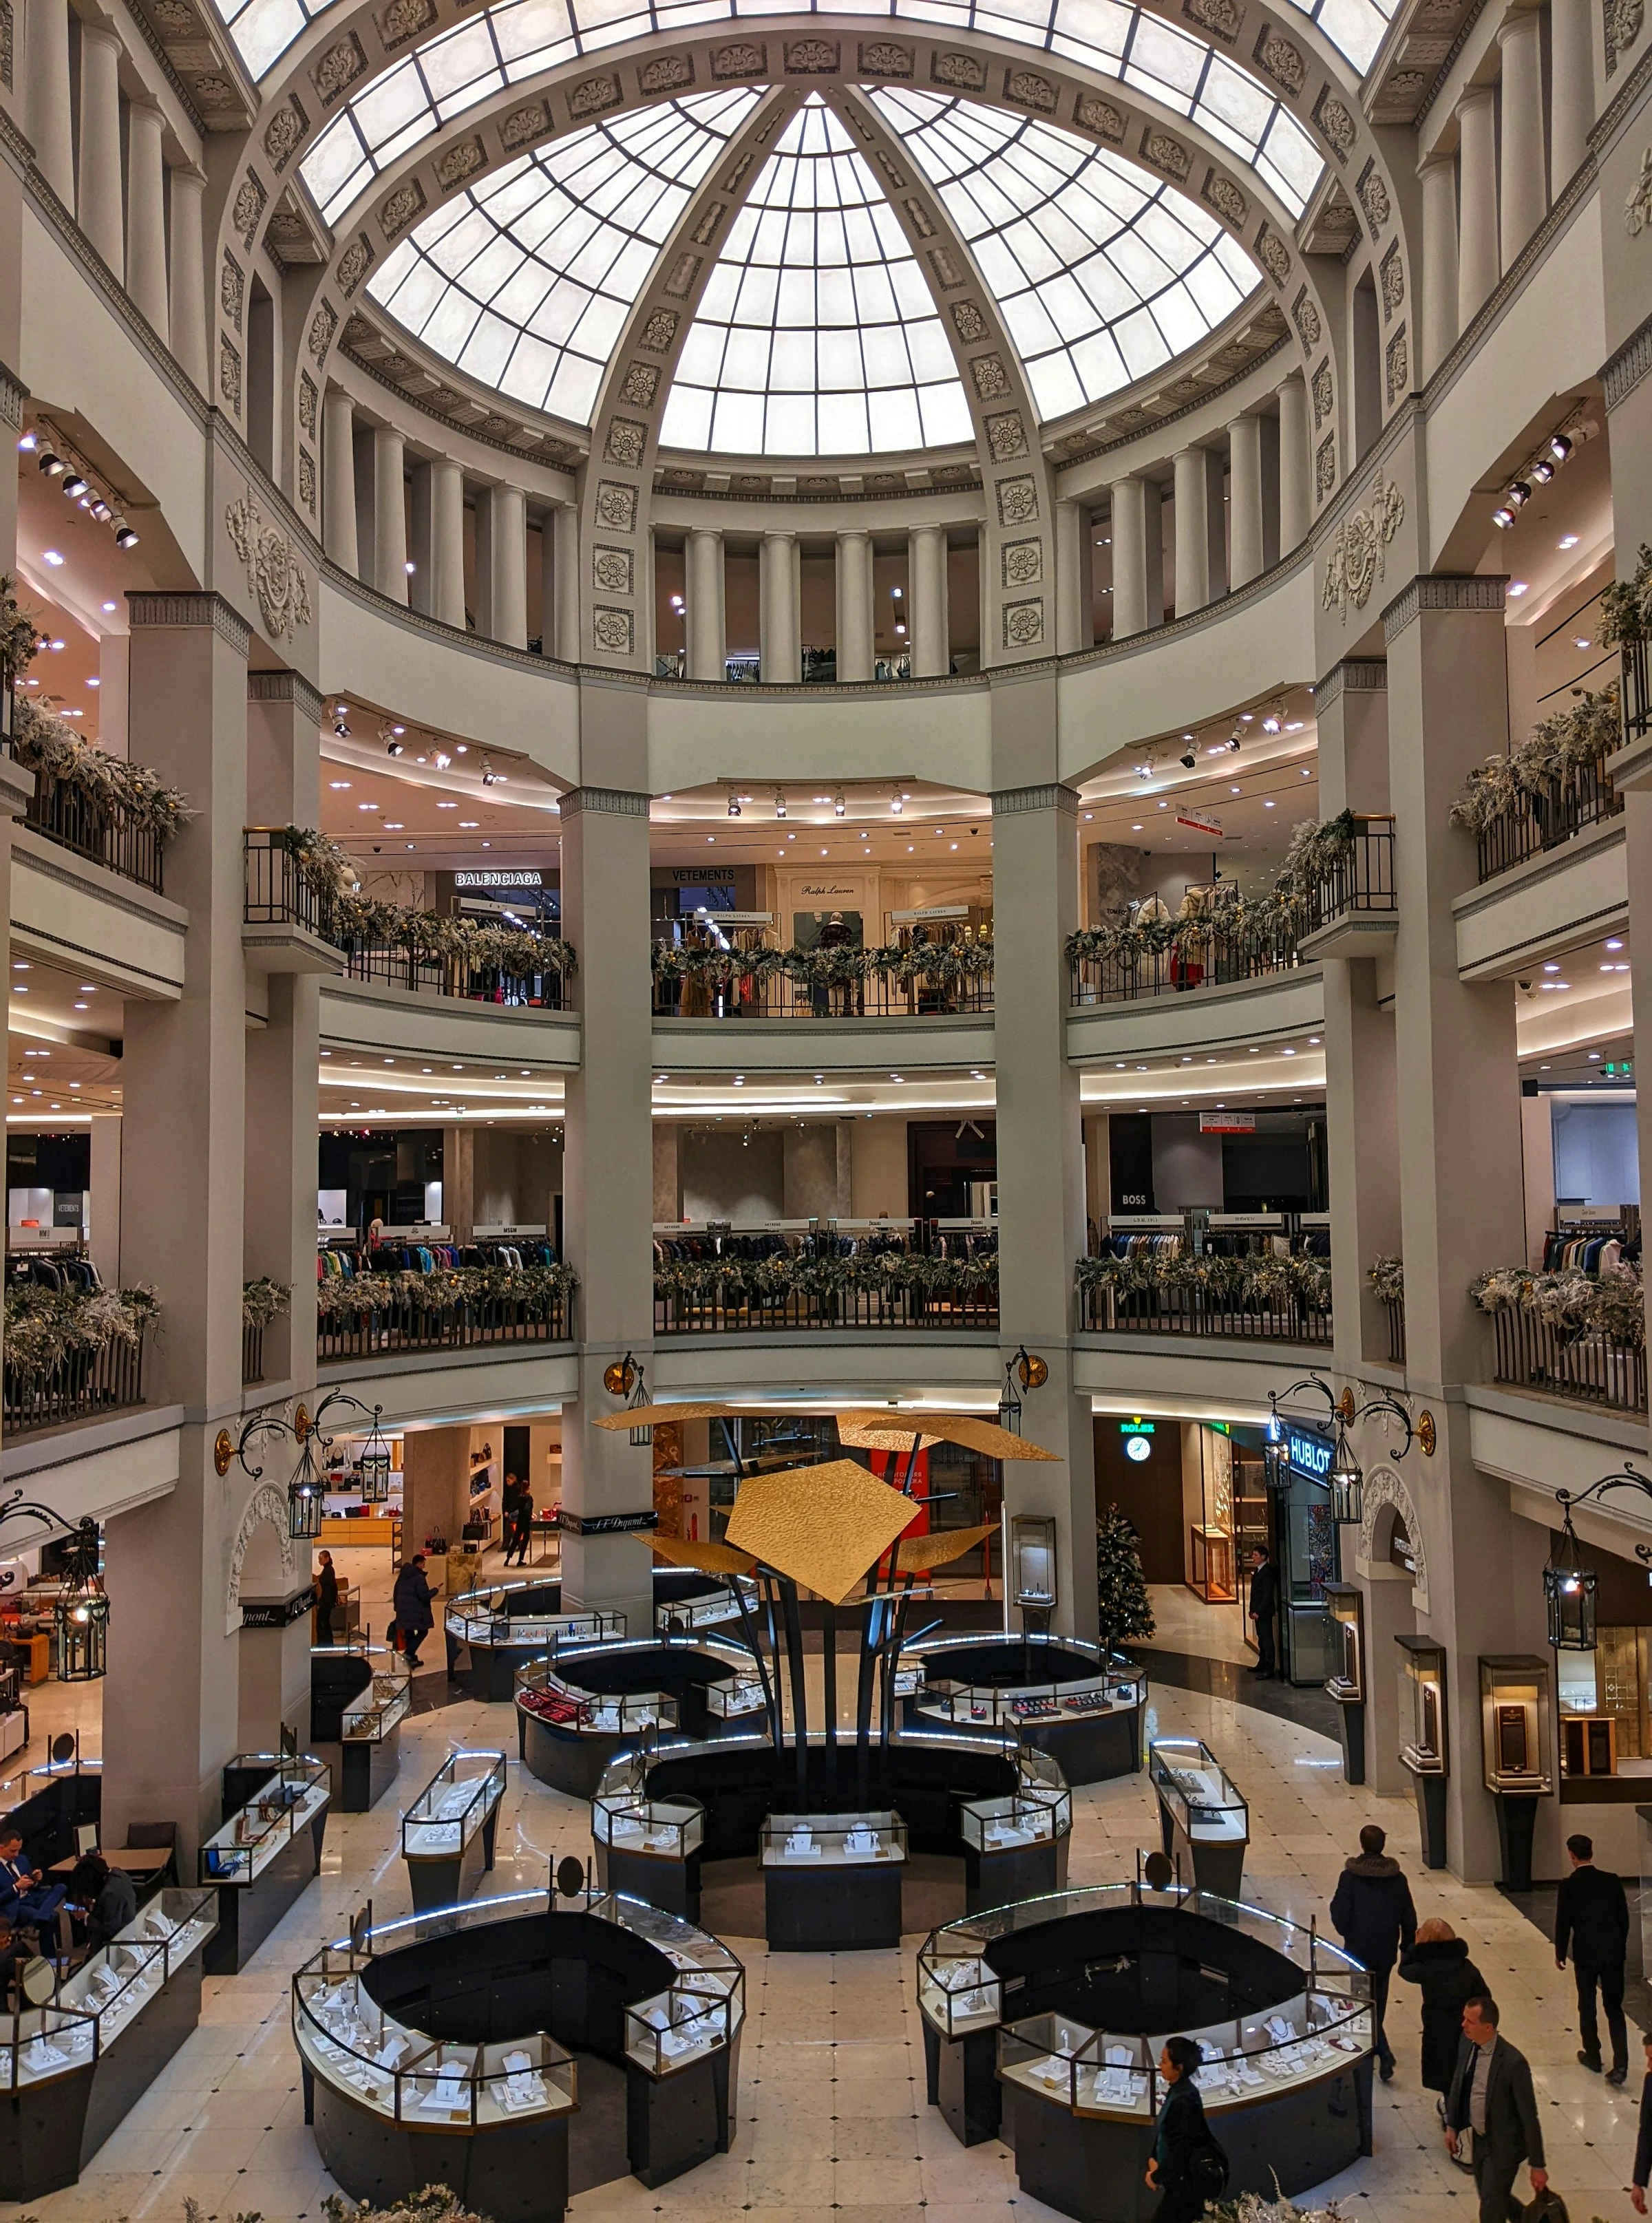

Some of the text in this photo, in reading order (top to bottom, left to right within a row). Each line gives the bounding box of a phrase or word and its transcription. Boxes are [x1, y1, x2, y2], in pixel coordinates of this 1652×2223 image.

[455, 872, 542, 886] BALENCIAGA
[673, 869, 734, 881] VETEMENTS
[801, 885, 854, 895] Ralph Lauren
[1122, 1195, 1146, 1204] BOSS
[58, 1204, 79, 1212] VETEMENTS
[1121, 1424, 1155, 1433] ROLEX
[1291, 1436, 1333, 1474] HUBLOT
[243, 1610, 276, 1626] pont
